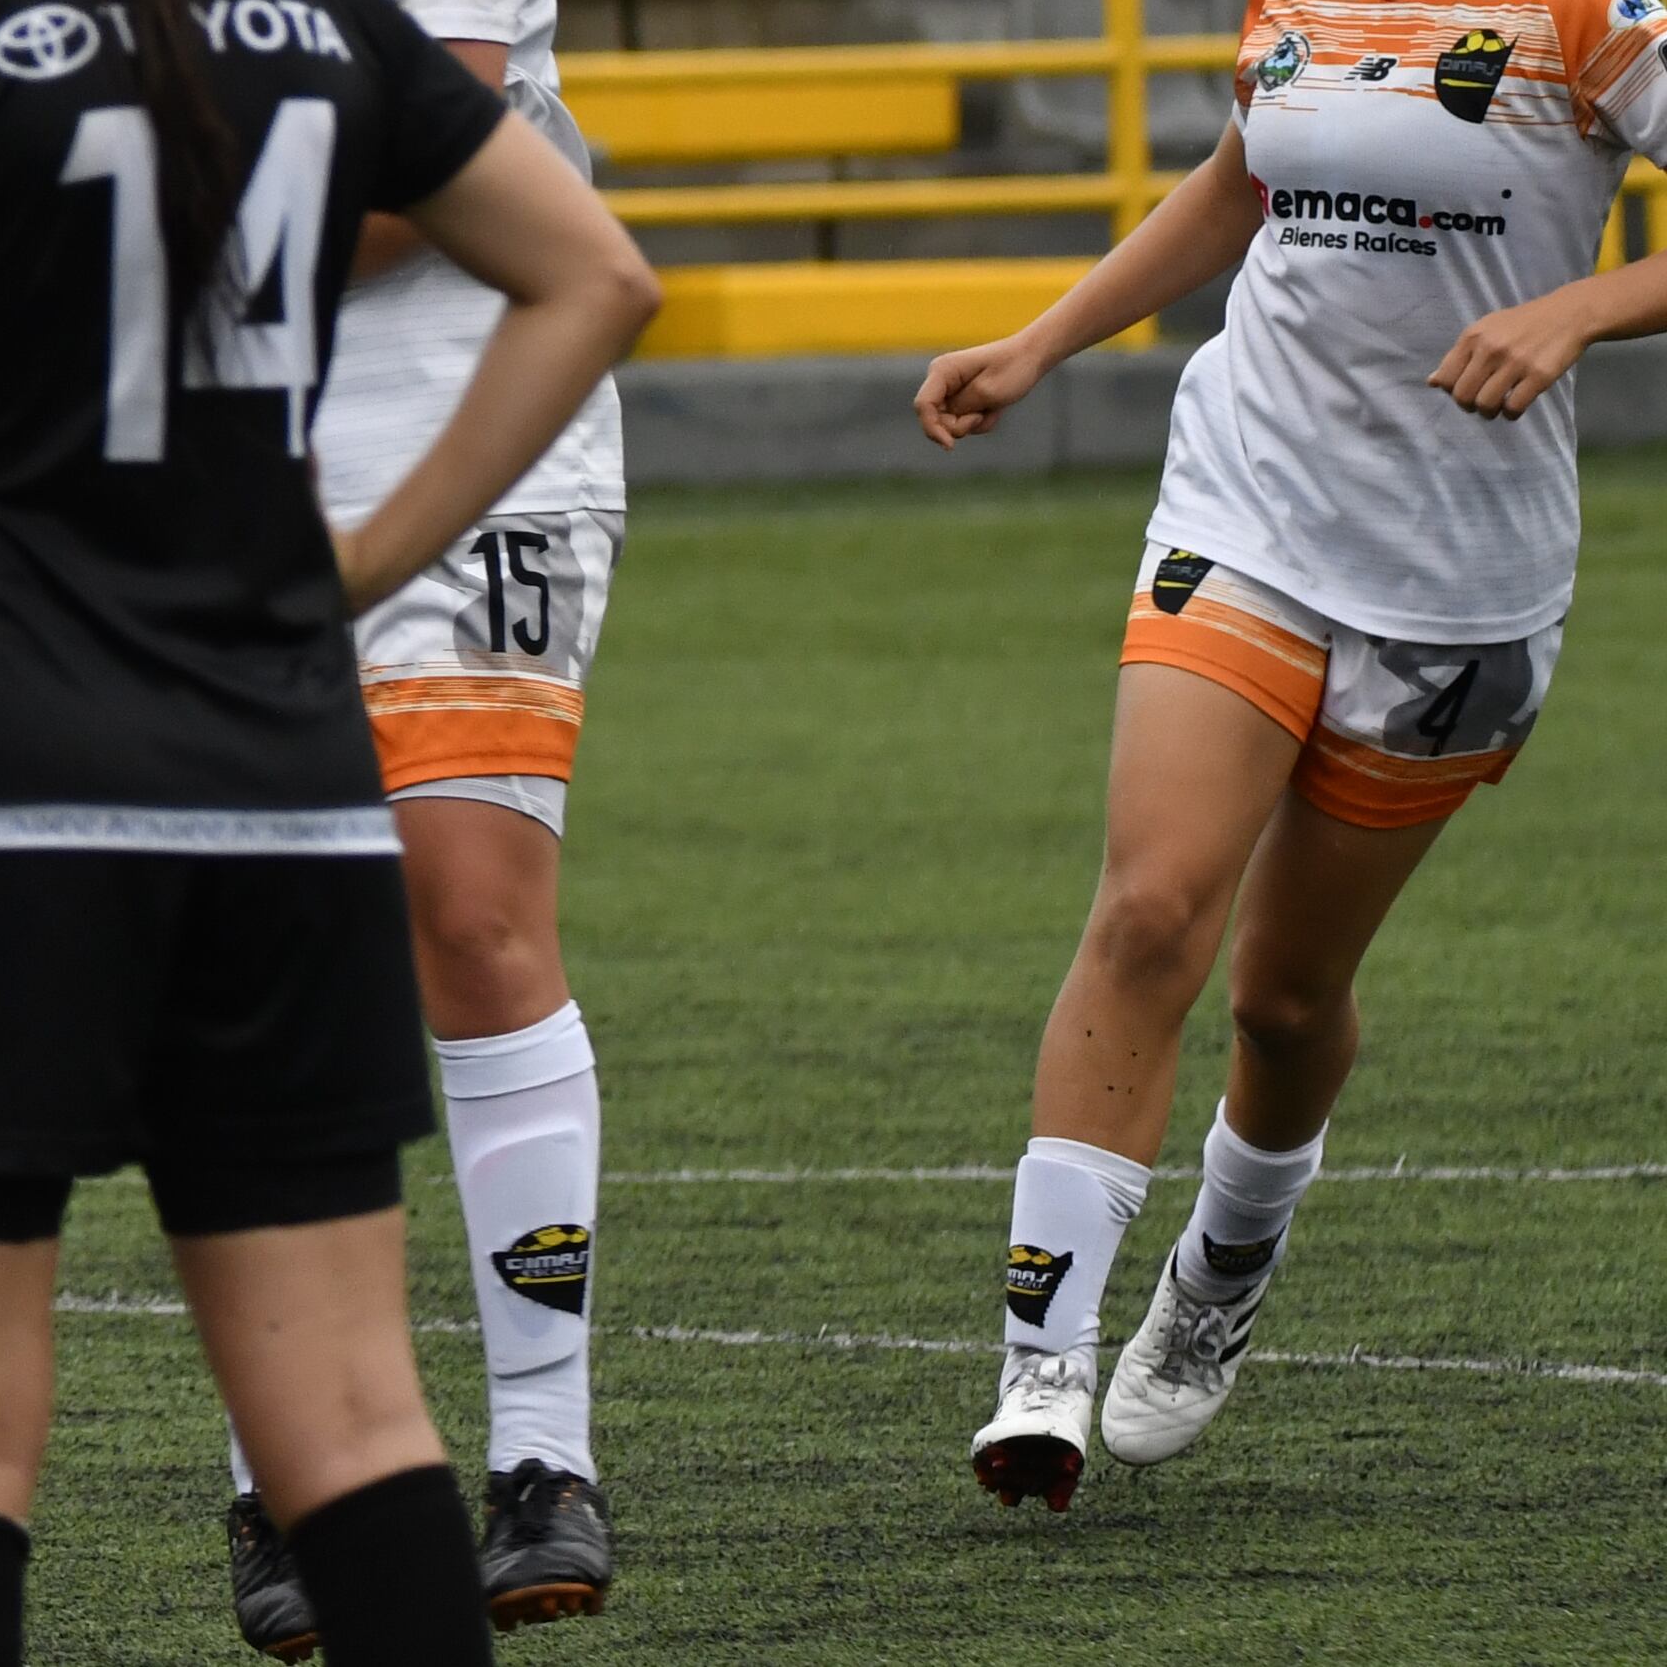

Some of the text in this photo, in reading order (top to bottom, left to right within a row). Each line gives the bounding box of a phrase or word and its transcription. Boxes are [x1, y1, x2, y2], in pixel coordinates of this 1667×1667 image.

[1271, 189, 1506, 236] emaca.com
[1279, 227, 1347, 250] Bienes
[60, 97, 338, 464] 14
[467, 531, 550, 657] 15
[1419, 659, 1480, 757] 4
